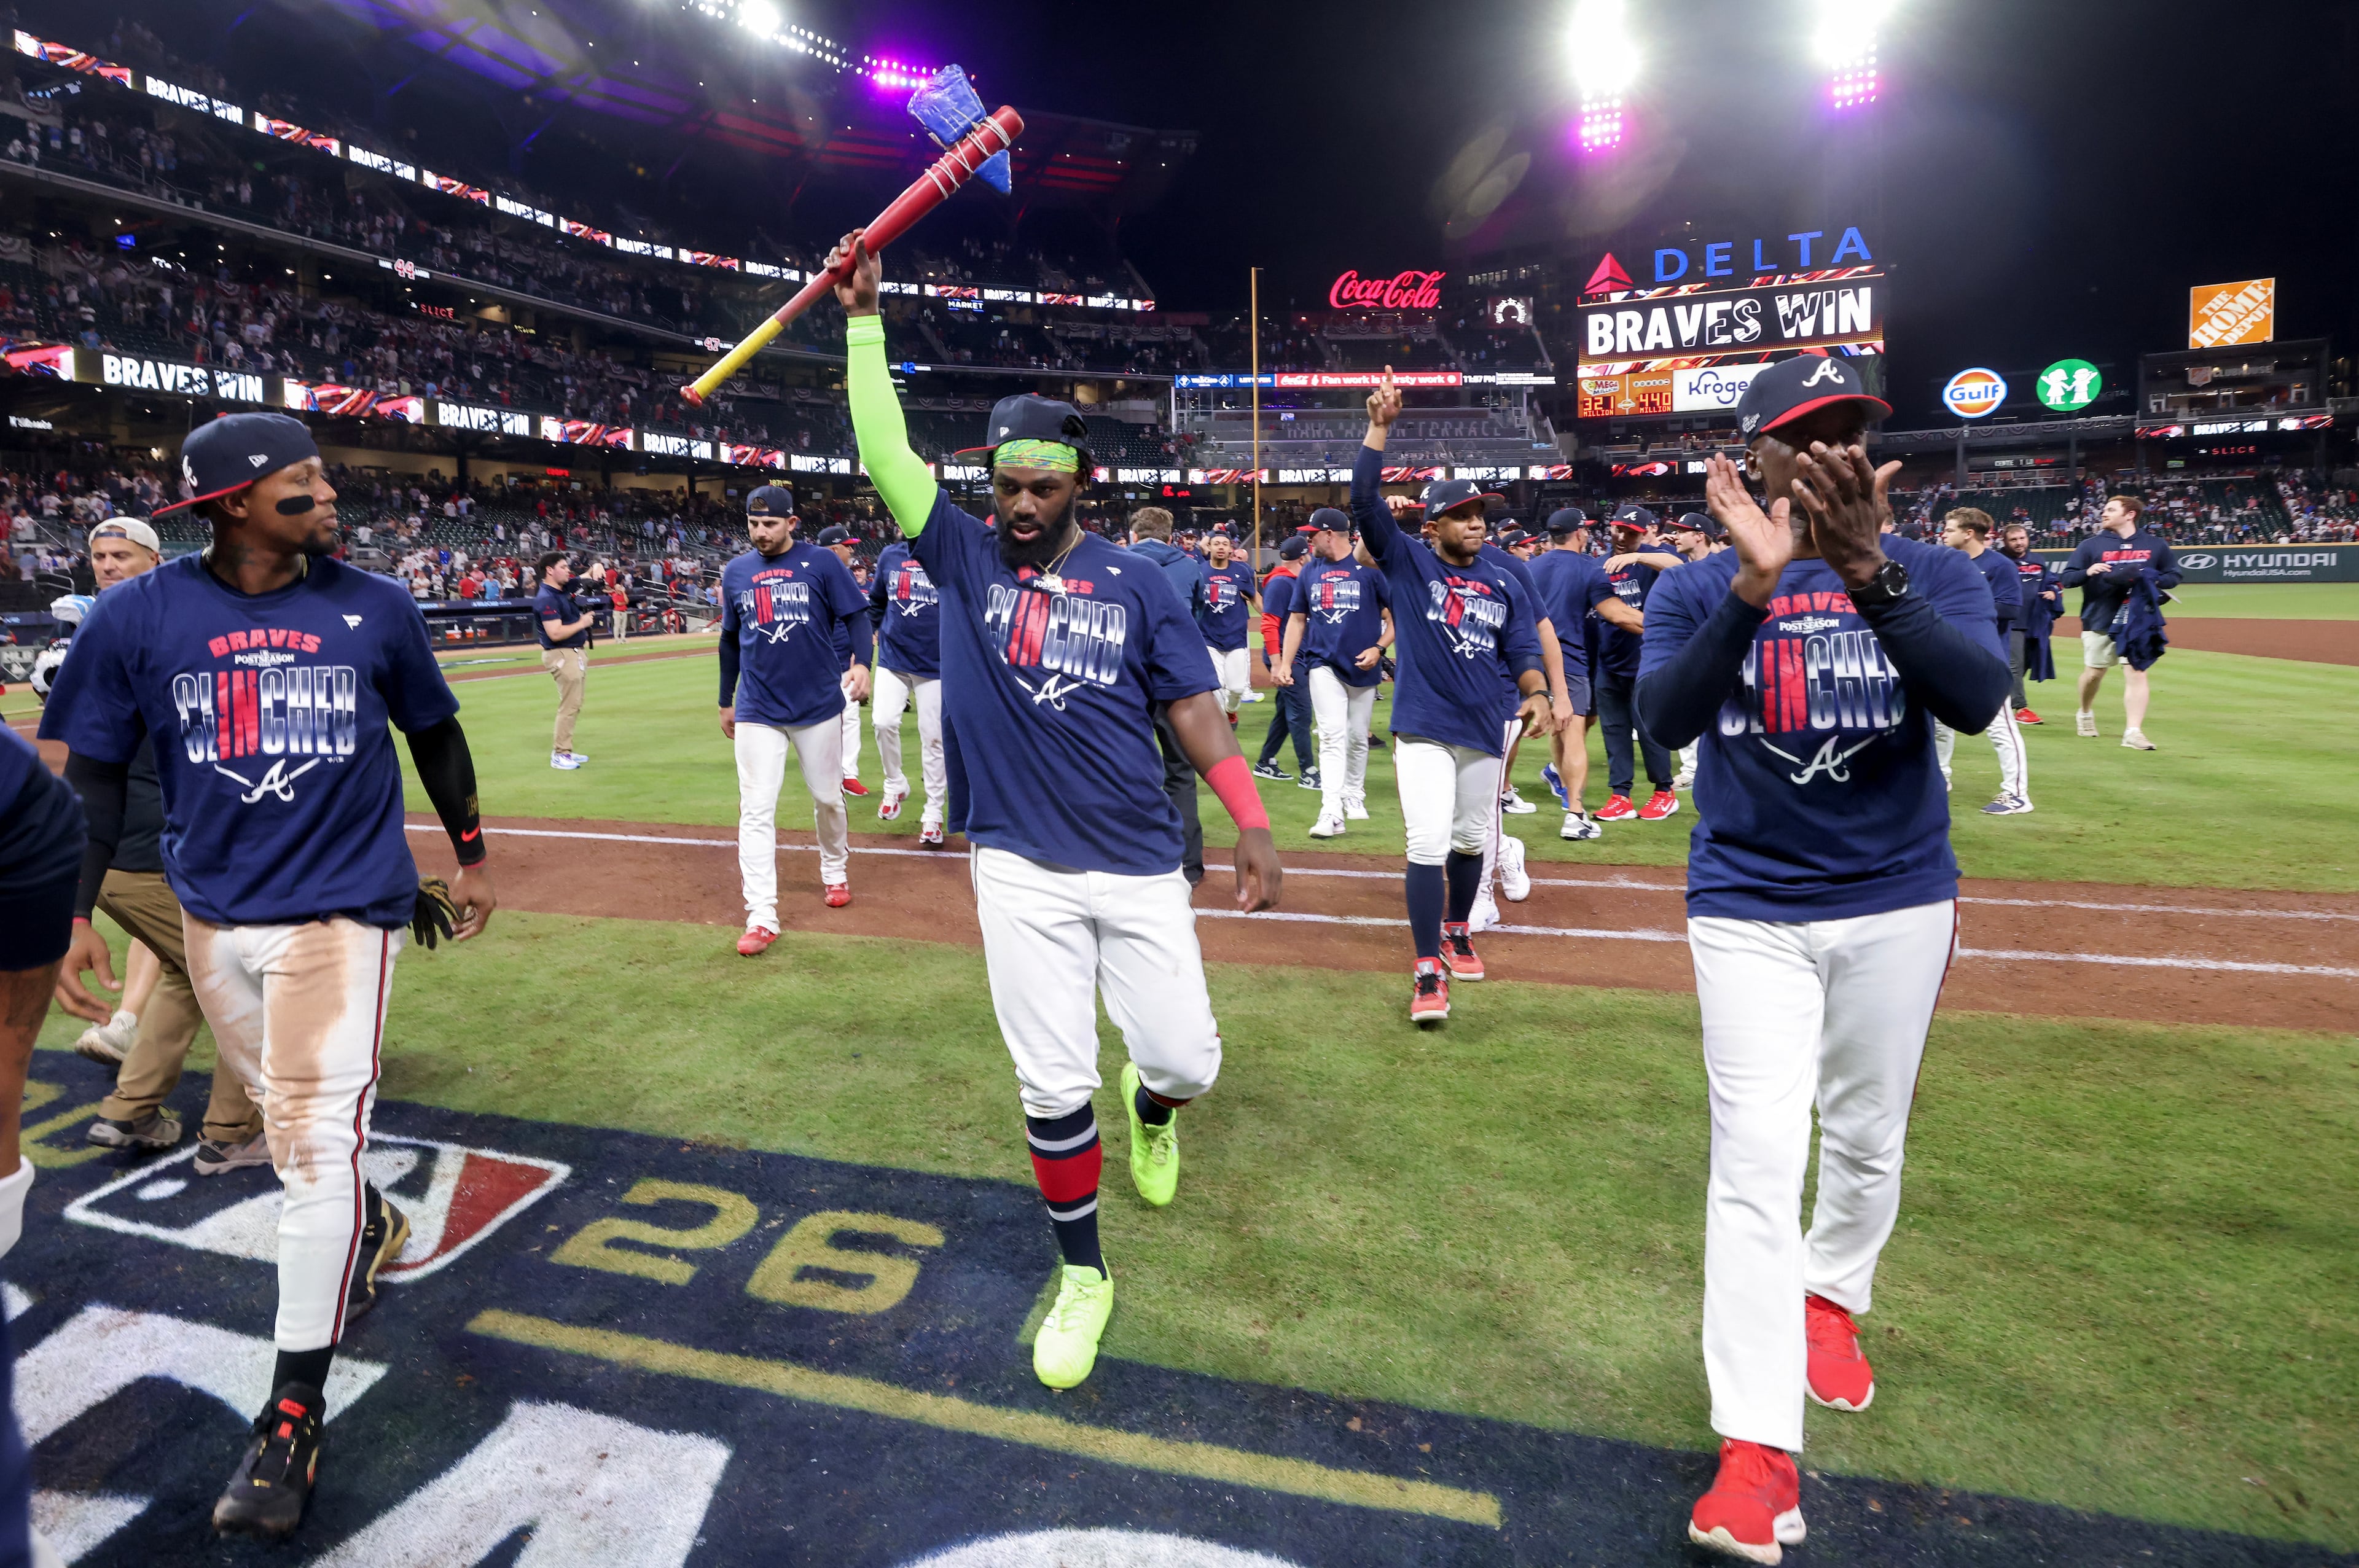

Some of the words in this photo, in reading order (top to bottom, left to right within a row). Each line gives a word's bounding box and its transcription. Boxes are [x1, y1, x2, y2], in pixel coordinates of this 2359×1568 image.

[146, 75, 209, 113] BRAVES
[212, 98, 243, 125] WIN
[348, 145, 392, 174] BRAVES
[394, 160, 415, 182] WIN
[496, 195, 534, 220] BRAVES
[616, 237, 652, 255] BRAVES
[1655, 227, 1872, 282] DELTA
[394, 258, 415, 280] 44
[745, 261, 780, 278] BRAVES
[878, 282, 900, 294] AVES
[984, 289, 1014, 301] BRAVES
[1329, 270, 1447, 308] Coca-Cola
[420, 303, 455, 319] SLICE
[948, 301, 984, 310] MARKET
[2191, 279, 2273, 346] HOME
[2198, 290, 2234, 317] THE
[1588, 298, 1761, 356] BRAVES
[1775, 287, 1872, 338] WIN
[2220, 302, 2273, 345] DEPOT
[703, 337, 720, 351] 47
[901, 362, 916, 373] 42
[102, 354, 209, 396] BRAVES
[214, 370, 263, 402] WIN
[1322, 376, 1340, 384] Fan
[1382, 375, 1416, 386] tirsty
[1689, 371, 1751, 404] Kroge
[1949, 384, 2000, 401] Gulf
[438, 402, 498, 432] BRAVES
[500, 412, 530, 436] WIN
[2194, 422, 2240, 435] BRAVES
[2244, 420, 2268, 432] WIN
[644, 432, 689, 457] BRAVES
[690, 439, 713, 460] WIN
[2212, 446, 2257, 455] SLICE
[791, 454, 826, 472] BRAVES
[827, 458, 850, 474] WIN
[1454, 467, 1496, 480] BRAVES
[1498, 466, 1520, 479] WIN
[1688, 461, 1707, 474] BRA
[1117, 469, 1158, 483] BRAVES
[1160, 469, 1181, 483] WIN
[1278, 469, 1326, 482] BRAVES
[1328, 469, 1353, 482] WIN
[2223, 553, 2337, 568] HYUNDAI
[751, 569, 794, 583] BRAVES
[1017, 566, 1095, 595] BES
[2223, 569, 2312, 578] HyundaiUSA.com
[1762, 591, 1858, 625] RAVE
[1779, 618, 1840, 631] POSTSEASON
[208, 628, 322, 659] BRAVES
[235, 652, 295, 666] POSTSEASON
[173, 665, 357, 763] CLINCHED
[549, 1177, 945, 1315] 26
